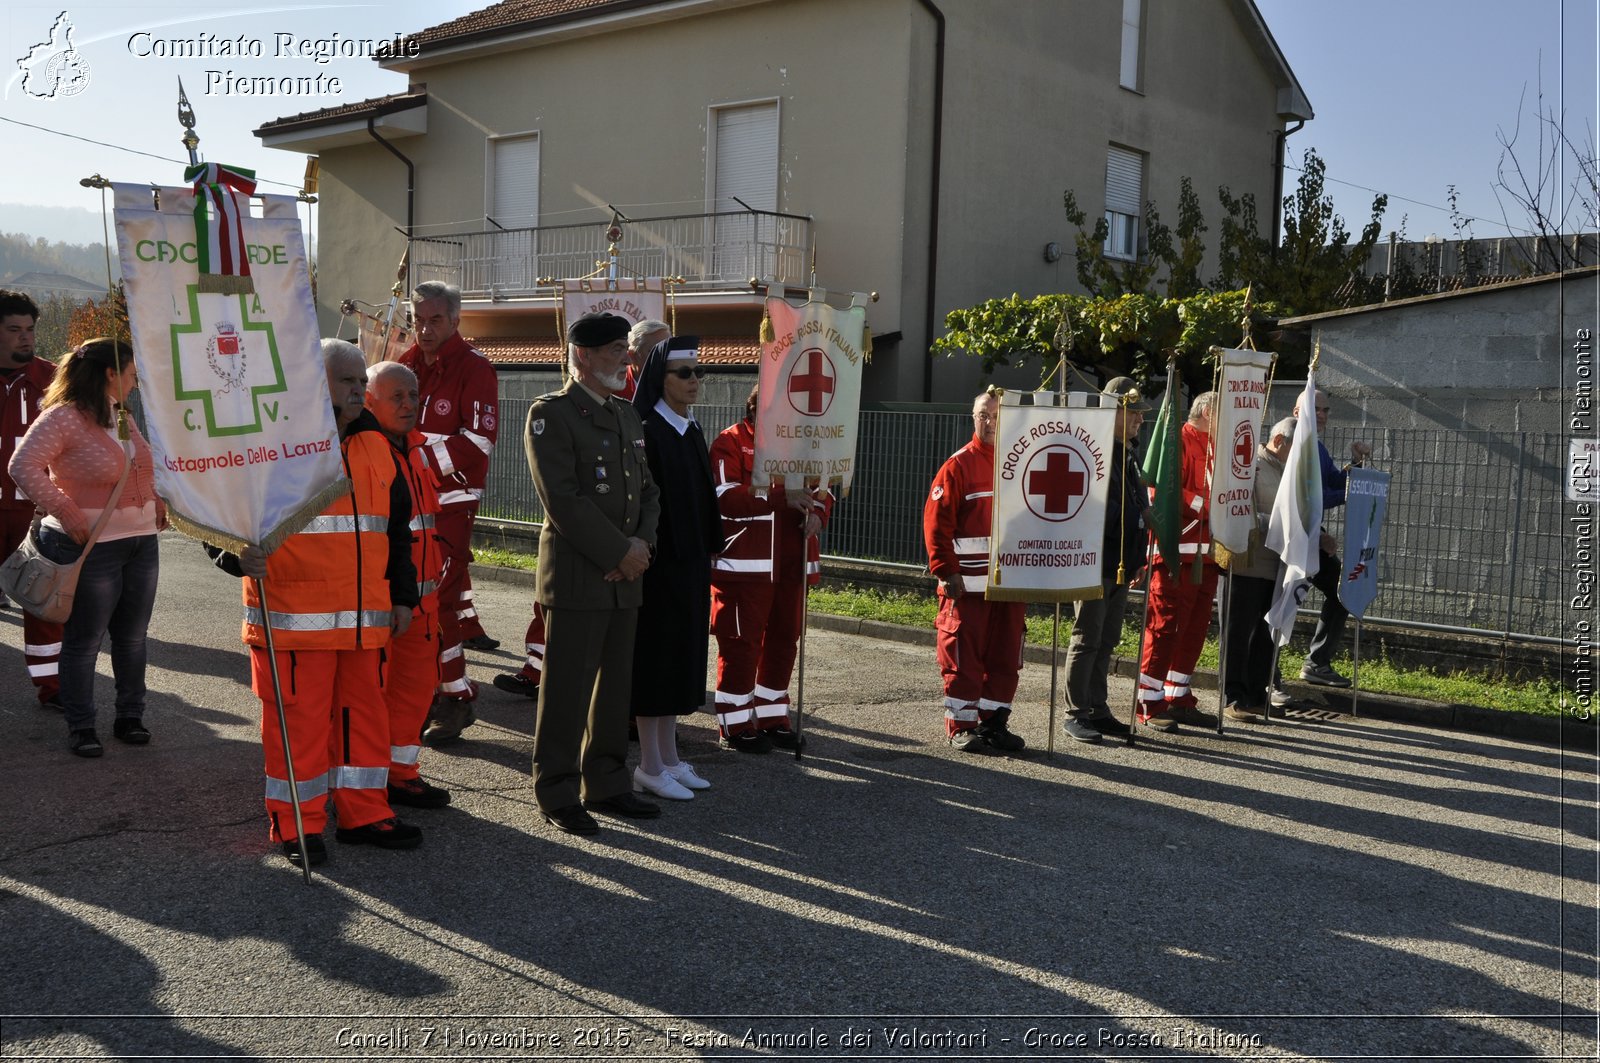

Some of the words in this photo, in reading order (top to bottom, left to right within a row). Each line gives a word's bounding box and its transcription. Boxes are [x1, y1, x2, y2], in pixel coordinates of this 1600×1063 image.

[770, 332, 797, 362] CROCE
[825, 327, 859, 367] ITALIANA
[183, 408, 202, 431] C.
[247, 446, 279, 465] Delle
[281, 438, 332, 459] Lanze
[811, 440, 820, 449] DI
[1001, 435, 1031, 481] CROCE
[1029, 421, 1072, 441] ROSSA
[1074, 426, 1105, 482] ITALIANA
[1231, 504, 1251, 516] CAN
[1018, 539, 1053, 550] COMITATO
[1054, 540, 1078, 550] LOCALE
[998, 553, 1072, 567] MONTEGROSSO
[1073, 552, 1097, 567] D'ASTI
